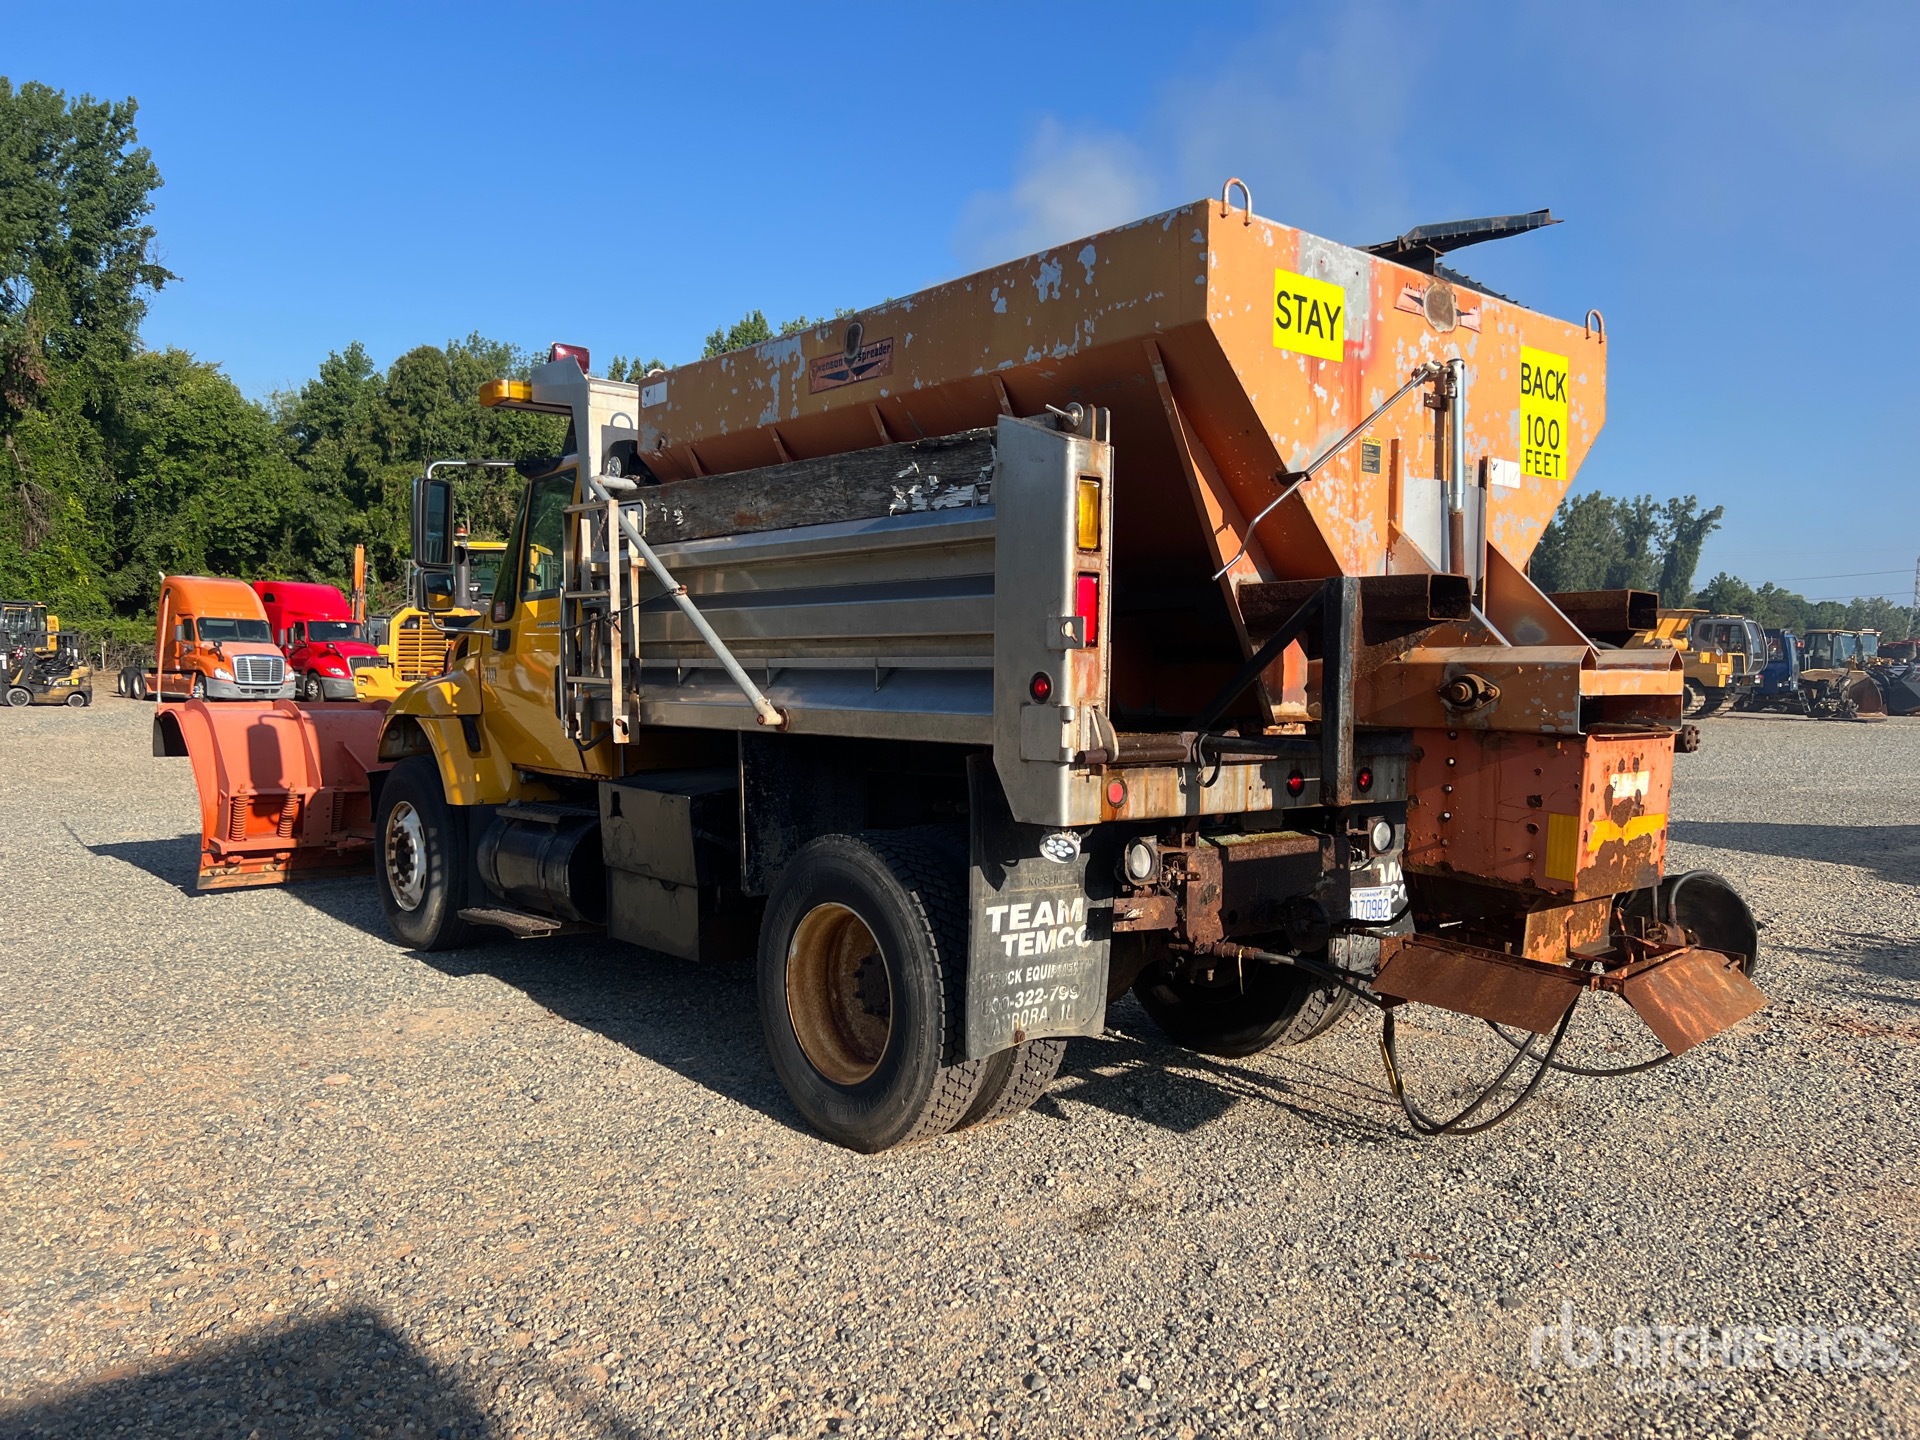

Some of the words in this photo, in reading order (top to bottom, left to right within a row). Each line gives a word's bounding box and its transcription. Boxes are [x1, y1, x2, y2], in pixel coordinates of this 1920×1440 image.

[1275, 290, 1342, 341] STAY
[1520, 362, 1567, 404] BACK
[1526, 413, 1560, 450] 100
[1525, 448, 1561, 478] FEET
[985, 897, 1085, 934] TEAM
[1000, 923, 1093, 957] TEMCO
